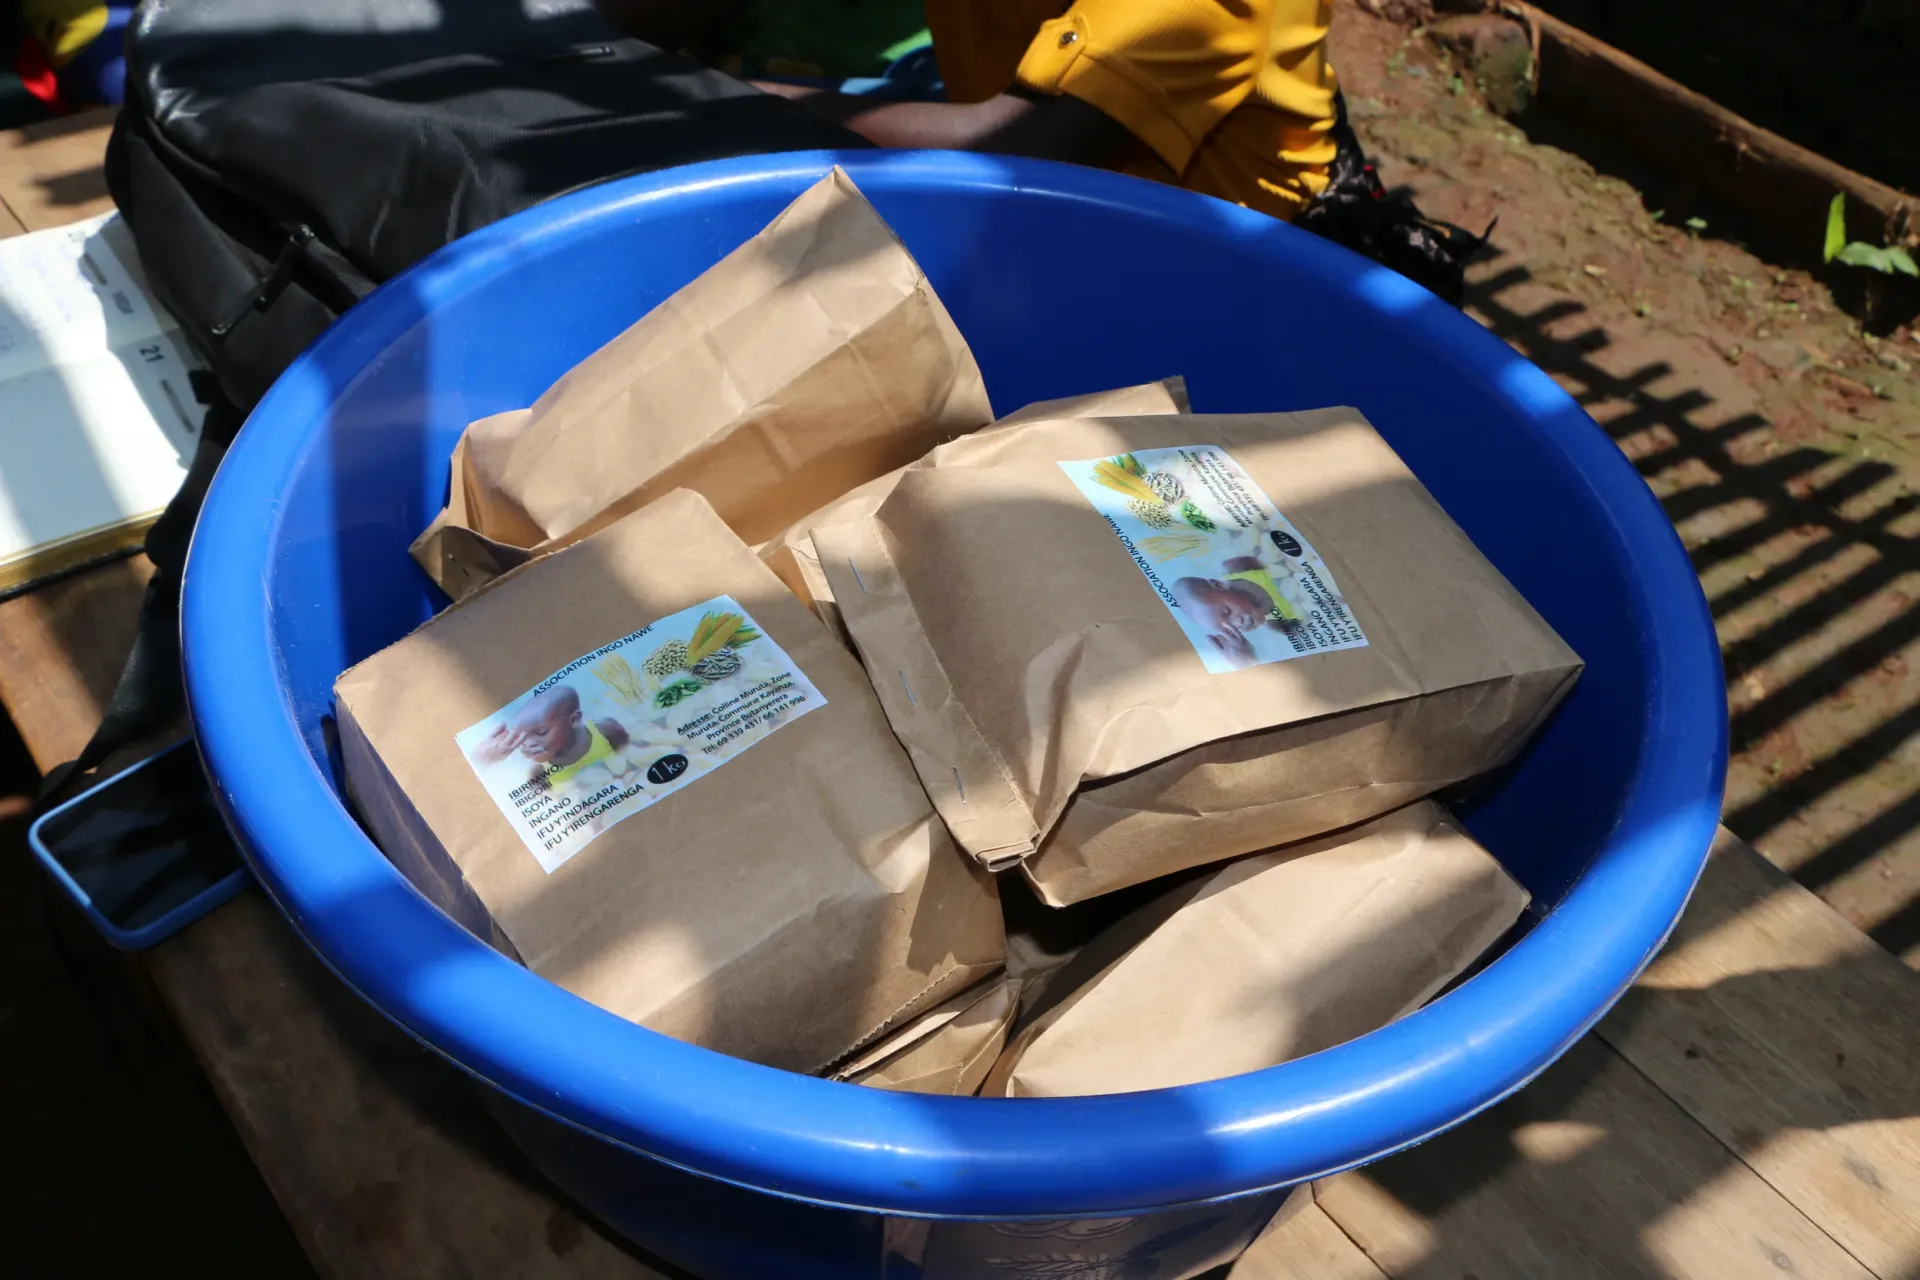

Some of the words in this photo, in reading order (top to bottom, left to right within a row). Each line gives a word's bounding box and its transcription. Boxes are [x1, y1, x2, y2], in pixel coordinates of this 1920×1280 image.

[138, 344, 165, 363] 21
[1103, 513, 1124, 535] NAWE
[1119, 535, 1140, 556] INGO
[1135, 556, 1181, 608] ASSOCIATION
[1300, 577, 1340, 628] Y'INDAGARA
[1307, 622, 1328, 648] ISOYA
[1311, 610, 1341, 645] INGANO
[1336, 628, 1352, 643] IFU
[1348, 626, 1364, 641] IFU
[533, 653, 597, 698] ASSOCIATION
[596, 640, 623, 657] INGO
[623, 624, 655, 645] NAWE
[676, 711, 714, 736] Adresse:
[712, 697, 740, 715] Colline
[770, 671, 793, 685] Zone
[686, 720, 720, 741] Muruta,
[718, 697, 760, 722] Commune
[759, 681, 796, 700] Kayanza,
[706, 717, 742, 741] Province
[740, 693, 789, 721] Butanyerera
[717, 736, 729, 747] 69
[727, 727, 744, 740] 339
[762, 711, 775, 721] 66
[774, 703, 789, 714] 141
[507, 763, 565, 800] IBIRIMWO:
[651, 766, 665, 781] 1
[514, 780, 553, 809] IBIGORI
[521, 795, 554, 819] ISOYA
[536, 823, 555, 840] IFU
[554, 784, 620, 827] Y'INDAGARA
[528, 797, 572, 829] INGANO
[544, 834, 563, 851] IFU
[561, 783, 645, 838] Y'IRENGARENGA
